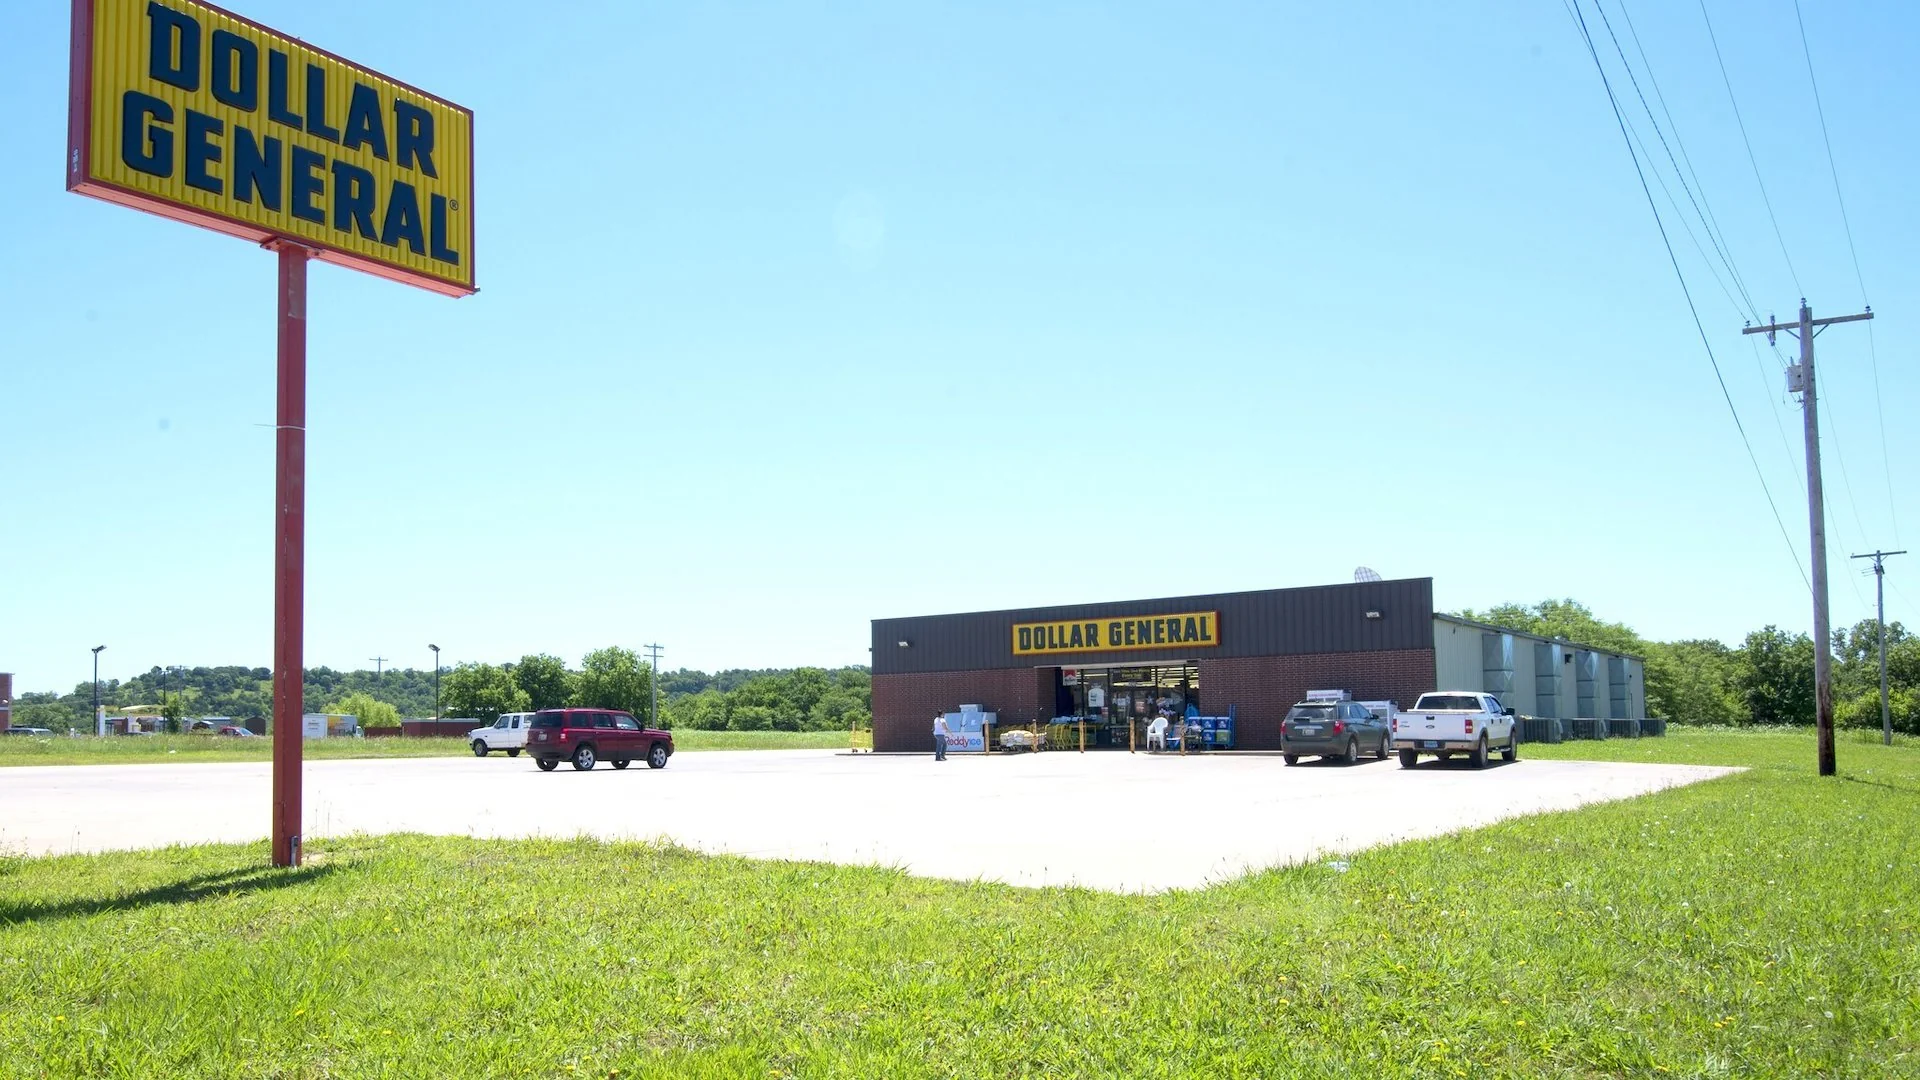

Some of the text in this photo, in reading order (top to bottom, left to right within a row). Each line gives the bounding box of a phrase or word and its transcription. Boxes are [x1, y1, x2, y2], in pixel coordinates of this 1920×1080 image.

[122, 90, 459, 266] GENERAL
[147, 1, 438, 179] DOLLAR
[1018, 616, 1212, 651] DOLLAR GENERAL
